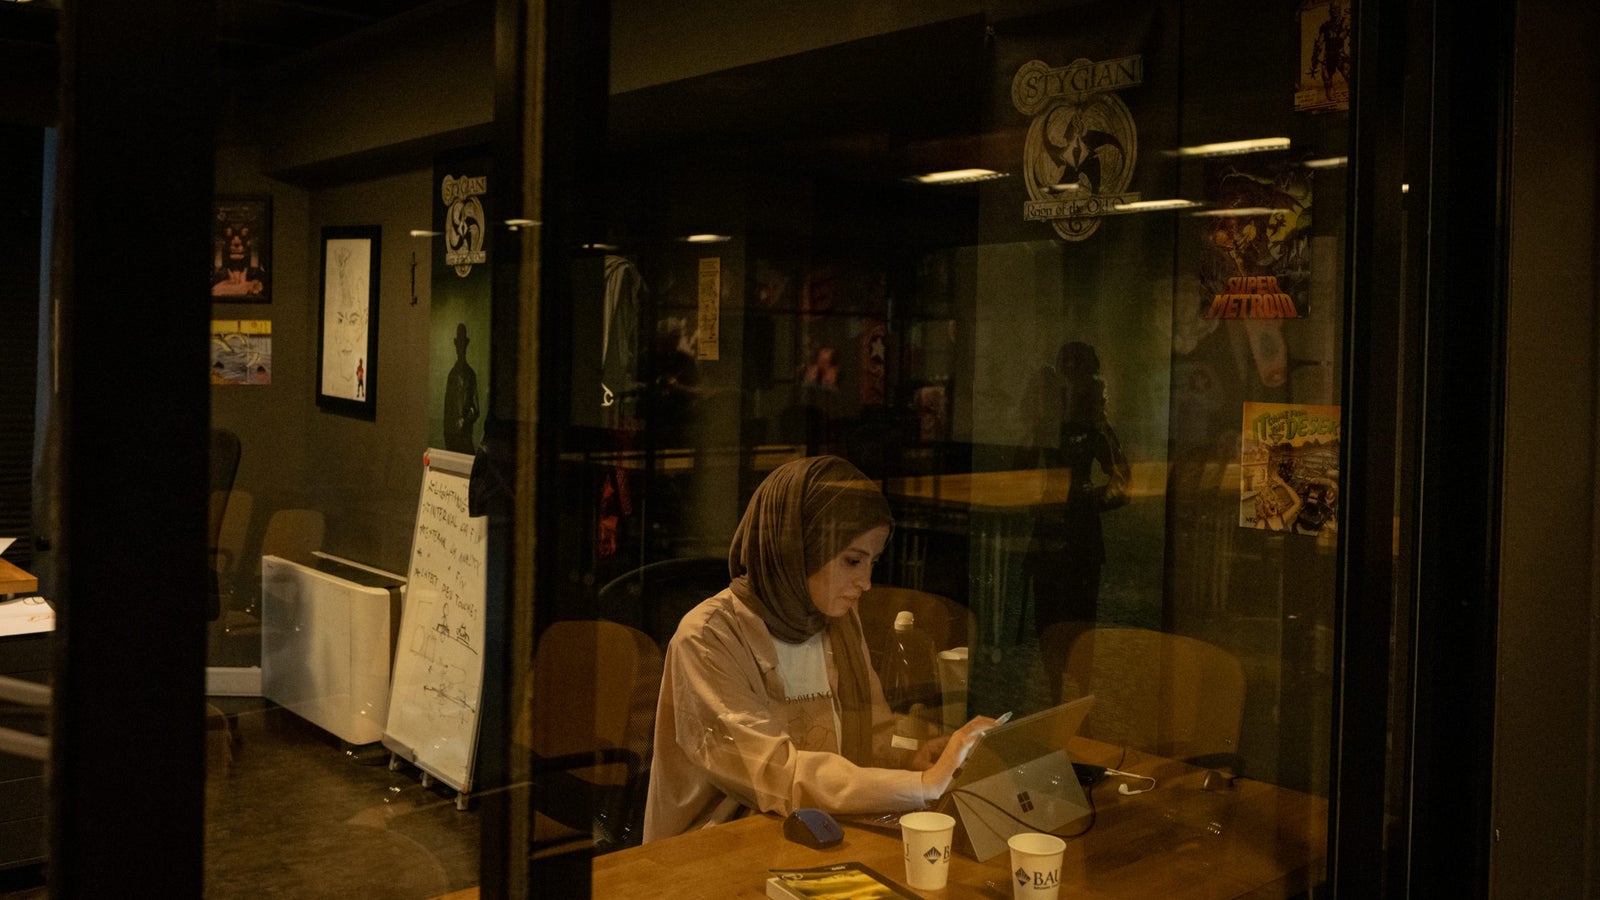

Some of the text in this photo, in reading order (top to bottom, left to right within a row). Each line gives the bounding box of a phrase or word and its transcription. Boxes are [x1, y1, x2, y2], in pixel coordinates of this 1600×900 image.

[1026, 60, 1137, 98] STYGIAN
[1028, 204, 1052, 217] Reign
[1056, 202, 1066, 215] of
[1227, 275, 1281, 294] SUPER
[1206, 294, 1298, 318] METROID
